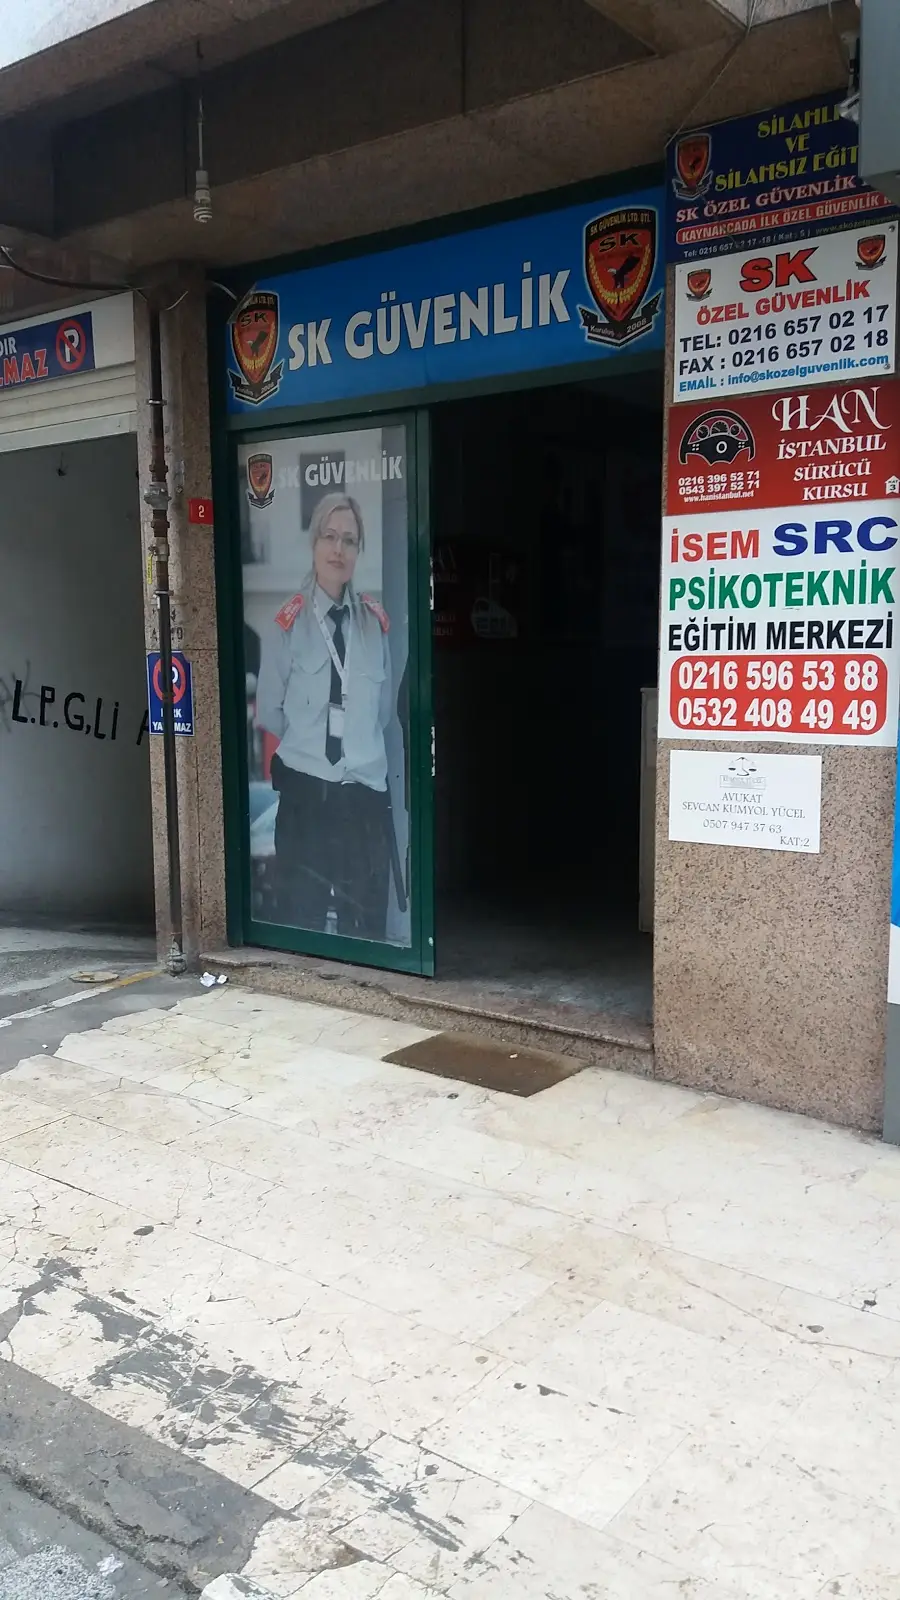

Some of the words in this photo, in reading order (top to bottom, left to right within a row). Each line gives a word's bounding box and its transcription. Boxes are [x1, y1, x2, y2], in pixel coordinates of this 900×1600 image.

[757, 104, 841, 138] SİLAHLI
[785, 132, 810, 153] VE
[714, 155, 809, 191] SİLAHSIZ
[675, 207, 699, 223] SK
[703, 196, 751, 217] ÖZEL
[755, 175, 857, 206] GÜVENLİK
[759, 213, 780, 229] İLK
[782, 208, 812, 224] ÖZEL
[815, 193, 880, 217] GÜVENLİK
[599, 233, 640, 253] SK
[684, 249, 698, 258] Tel:
[739, 246, 820, 292] SK
[287, 318, 333, 371] SK
[344, 261, 571, 360] GÜVENLİK
[696, 302, 750, 326] ÖZEL
[755, 279, 871, 316] GÜVENLİK
[680, 335, 722, 353] TEL:
[728, 323, 777, 345] 0216
[783, 315, 822, 337] 657
[828, 310, 855, 330] 02
[863, 304, 889, 324] 17
[0, 348, 49, 387] MAZ
[679, 355, 714, 376] FAX
[732, 345, 779, 368] 0216
[786, 338, 823, 360] 657
[830, 334, 855, 353] 02
[863, 329, 889, 348] 18
[679, 376, 717, 392] EMAİL
[727, 354, 889, 386] info@skozelguvenlik.com
[772, 386, 892, 433] HAN
[776, 433, 887, 460] İSTANBUL
[304, 450, 403, 486] GÜVENLİK
[678, 475, 704, 487] 0216
[707, 473, 727, 485] 396
[730, 472, 744, 482] 52
[747, 470, 760, 480] 71
[793, 458, 872, 482] SÜRÜCÜ
[679, 485, 705, 496] 0543
[707, 482, 727, 493] 397
[730, 480, 744, 490] 52
[747, 479, 760, 489] 71
[801, 482, 868, 501] KURSU
[198, 505, 205, 518] 2
[670, 528, 760, 563] İSEM
[772, 516, 899, 557] SRC
[669, 559, 896, 611] PSİKOTEKNİK
[668, 616, 756, 651] EĞİTİM
[766, 611, 893, 650] MERKEZİ
[678, 661, 738, 690] 0216
[746, 660, 794, 691] 596
[802, 660, 835, 691] 53
[844, 660, 879, 692] 88
[677, 697, 737, 727] 0532
[744, 698, 792, 728] 408
[800, 699, 834, 729] 49
[842, 699, 878, 730] 49
[682, 801, 720, 813] SEVCAN
[722, 805, 768, 817] KUMYOL
[771, 806, 806, 819] YÜCEL
[721, 792, 763, 804] AVUKAT
[703, 818, 728, 830] 0507
[731, 821, 749, 831] 947
[753, 823, 766, 833] 37
[769, 824, 782, 834] 63
[780, 835, 810, 848] KAT:2
